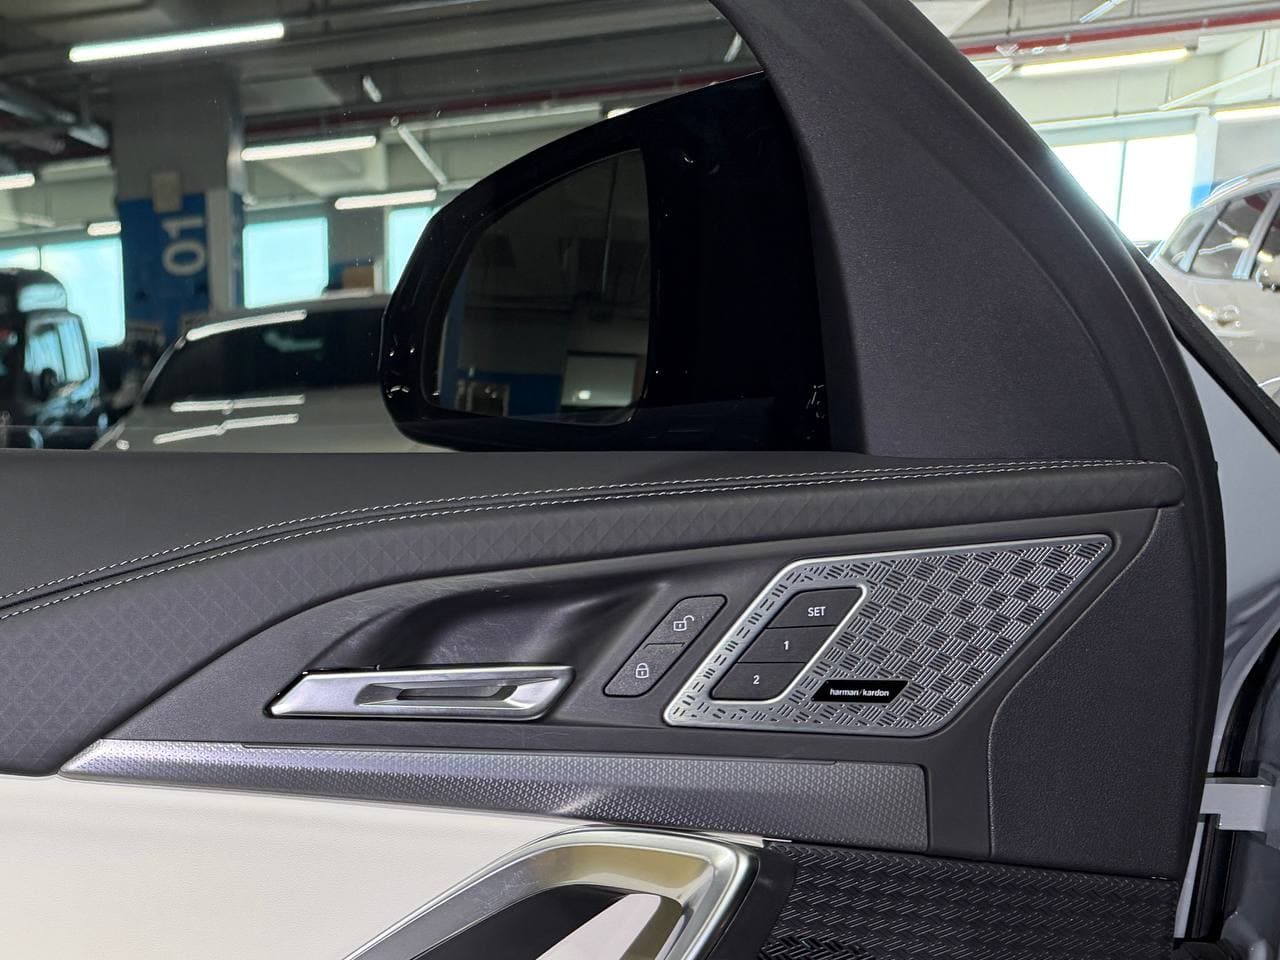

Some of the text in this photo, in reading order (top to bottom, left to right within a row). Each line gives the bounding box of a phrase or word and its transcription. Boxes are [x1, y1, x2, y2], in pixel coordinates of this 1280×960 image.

[807, 606, 826, 617] SET
[783, 640, 790, 650] 1
[752, 675, 761, 685] 2
